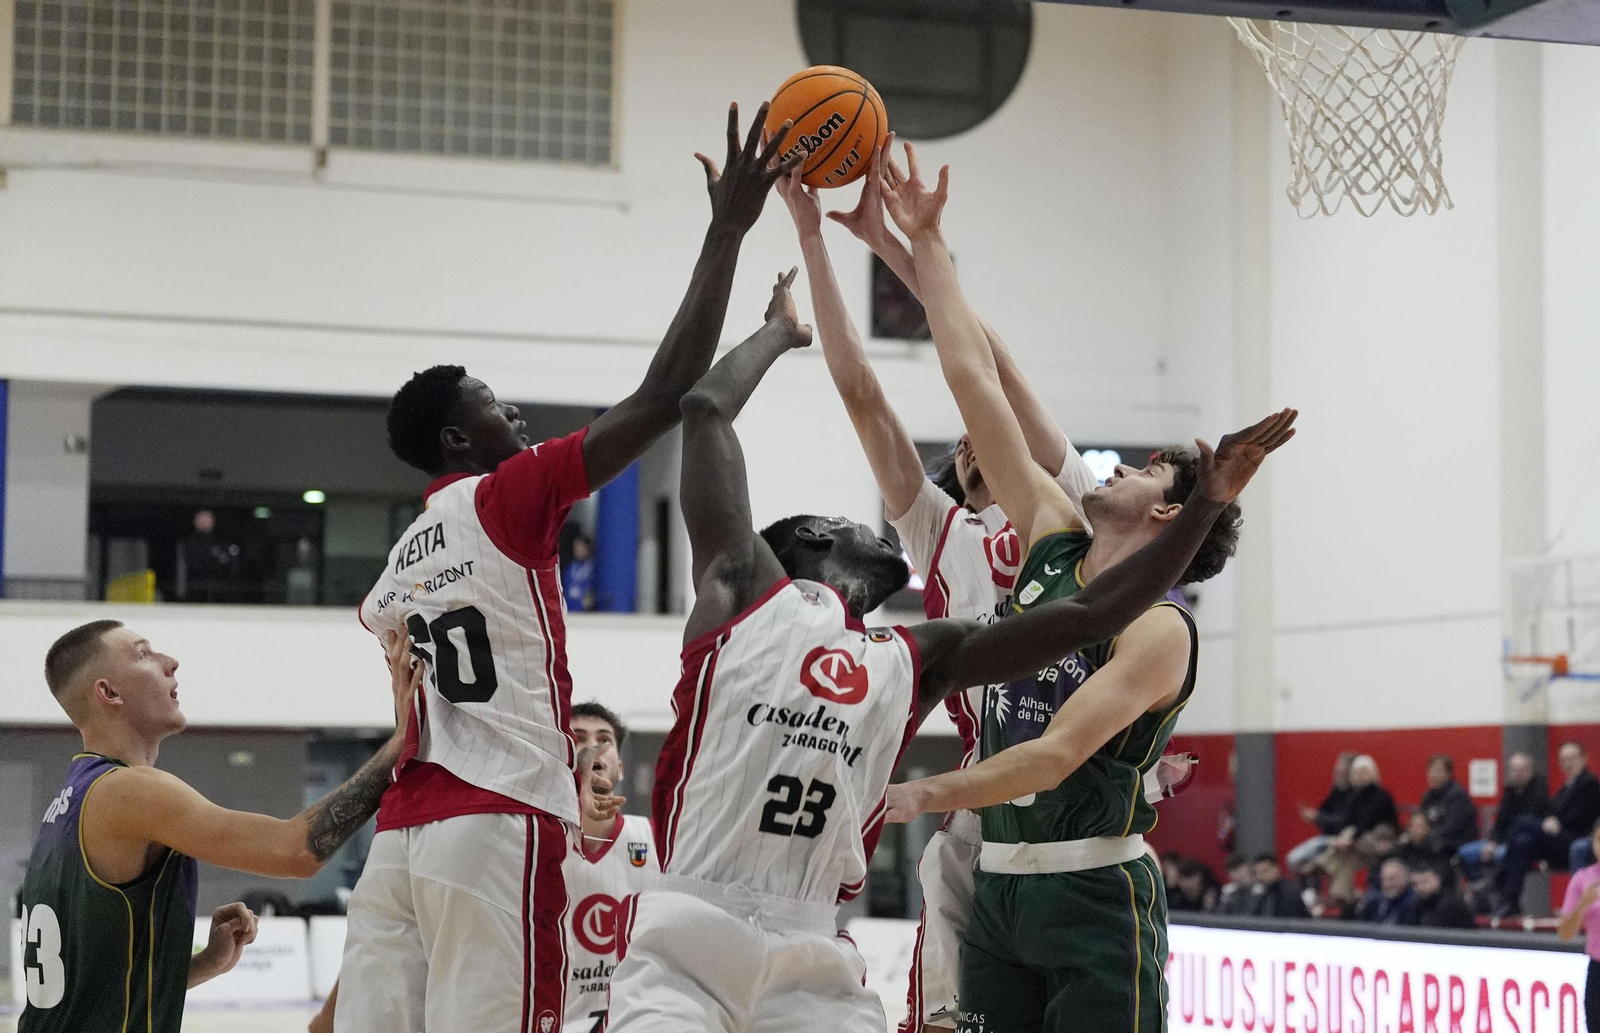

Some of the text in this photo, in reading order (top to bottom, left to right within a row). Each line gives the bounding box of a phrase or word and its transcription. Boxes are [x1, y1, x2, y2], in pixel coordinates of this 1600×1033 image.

[395, 521, 446, 575] KEITA
[377, 560, 474, 613] AIR HORIZONT
[1017, 708, 1031, 721] de
[1033, 710, 1045, 723] la
[758, 773, 837, 839] 23
[21, 903, 66, 1010] 3
